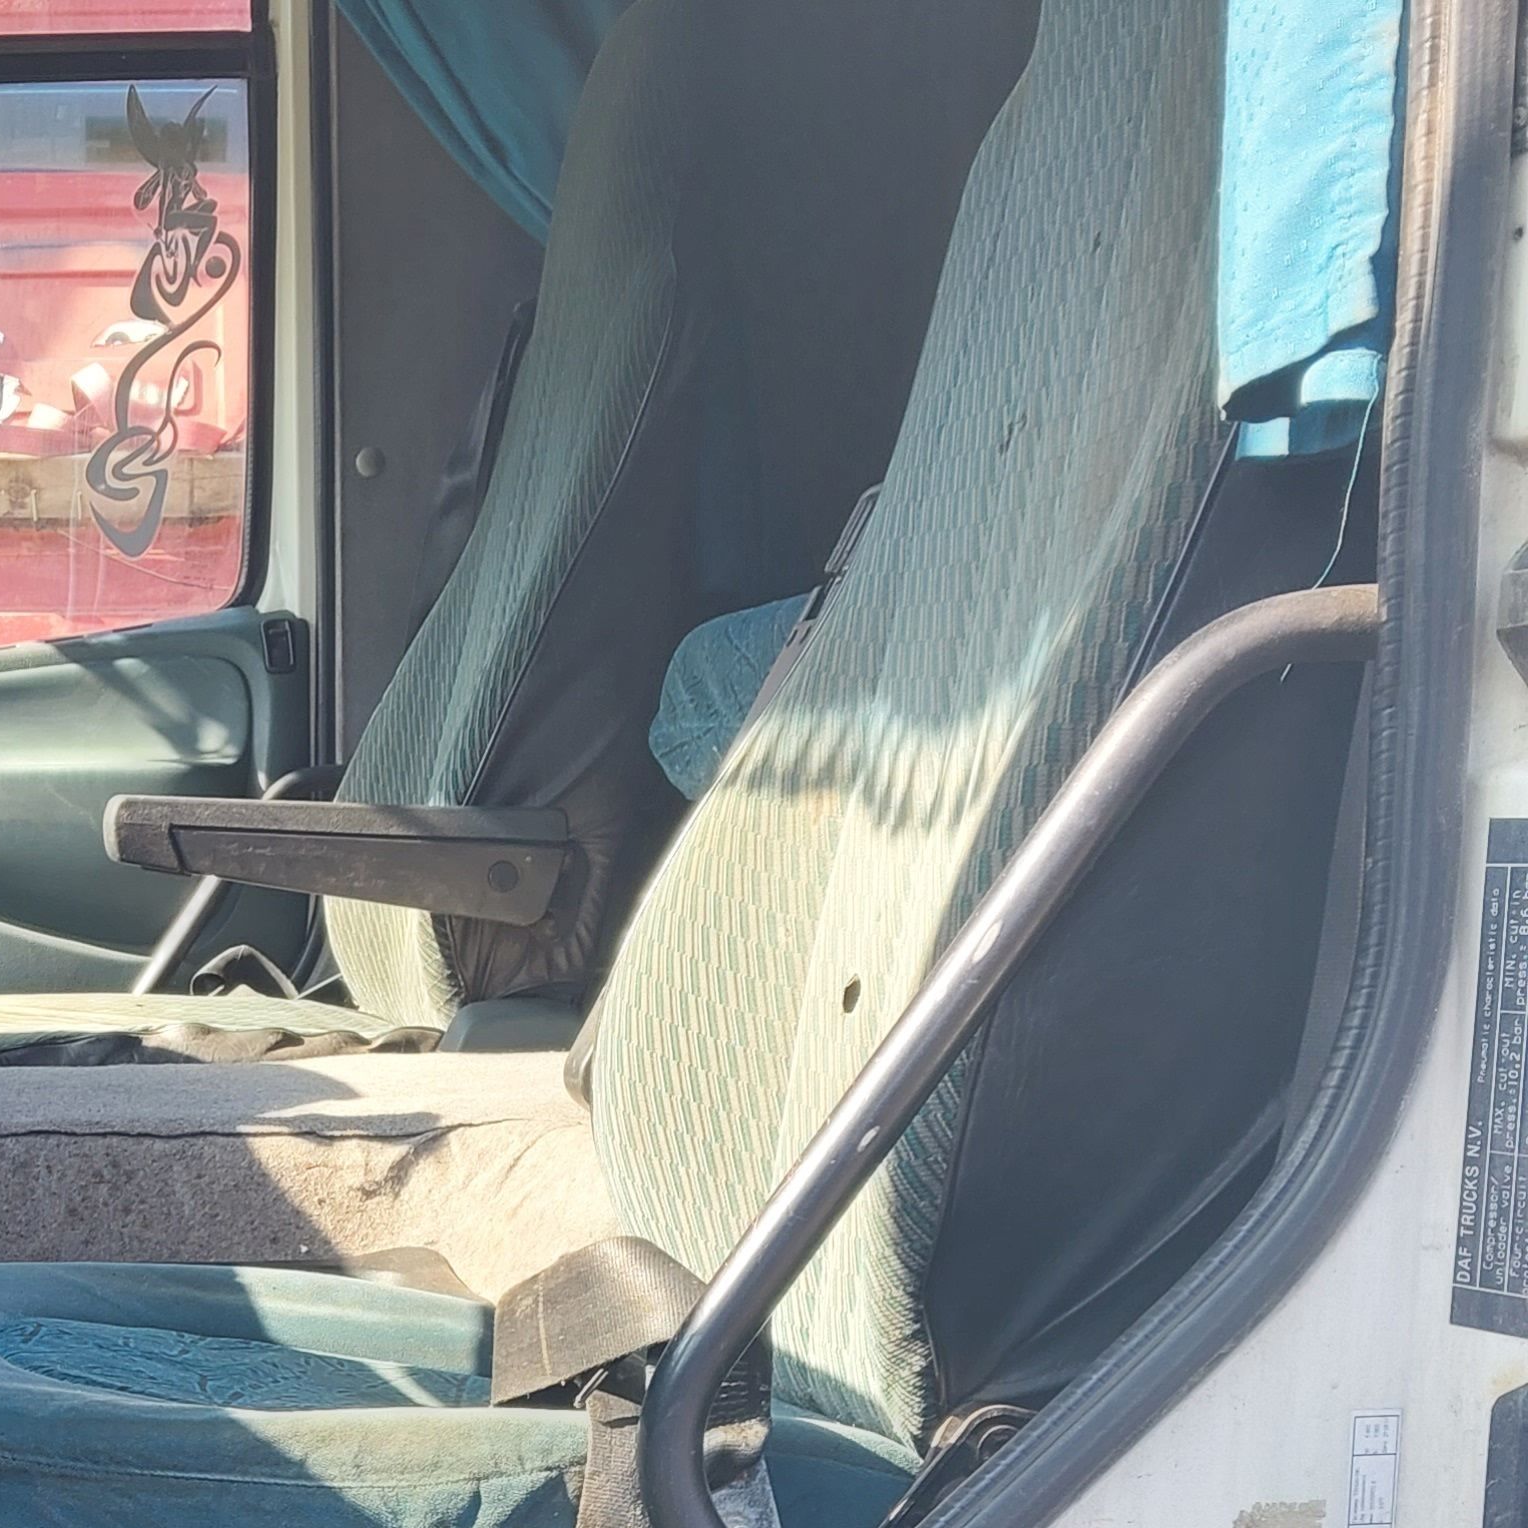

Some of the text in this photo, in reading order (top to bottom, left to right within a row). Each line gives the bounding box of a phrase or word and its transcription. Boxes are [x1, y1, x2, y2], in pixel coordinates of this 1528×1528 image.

[1477, 888, 1500, 1083] Pneumatic characteristic data
[1504, 954, 1517, 987] MIN.
[1512, 1018, 1522, 1044] bar
[1493, 1101, 1505, 1134] MAX.
[1456, 1121, 1483, 1283] DAF TRUCKS N.V.
[1482, 1176, 1499, 1270] Compressor/
[1494, 1165, 1512, 1285] unloader valve
